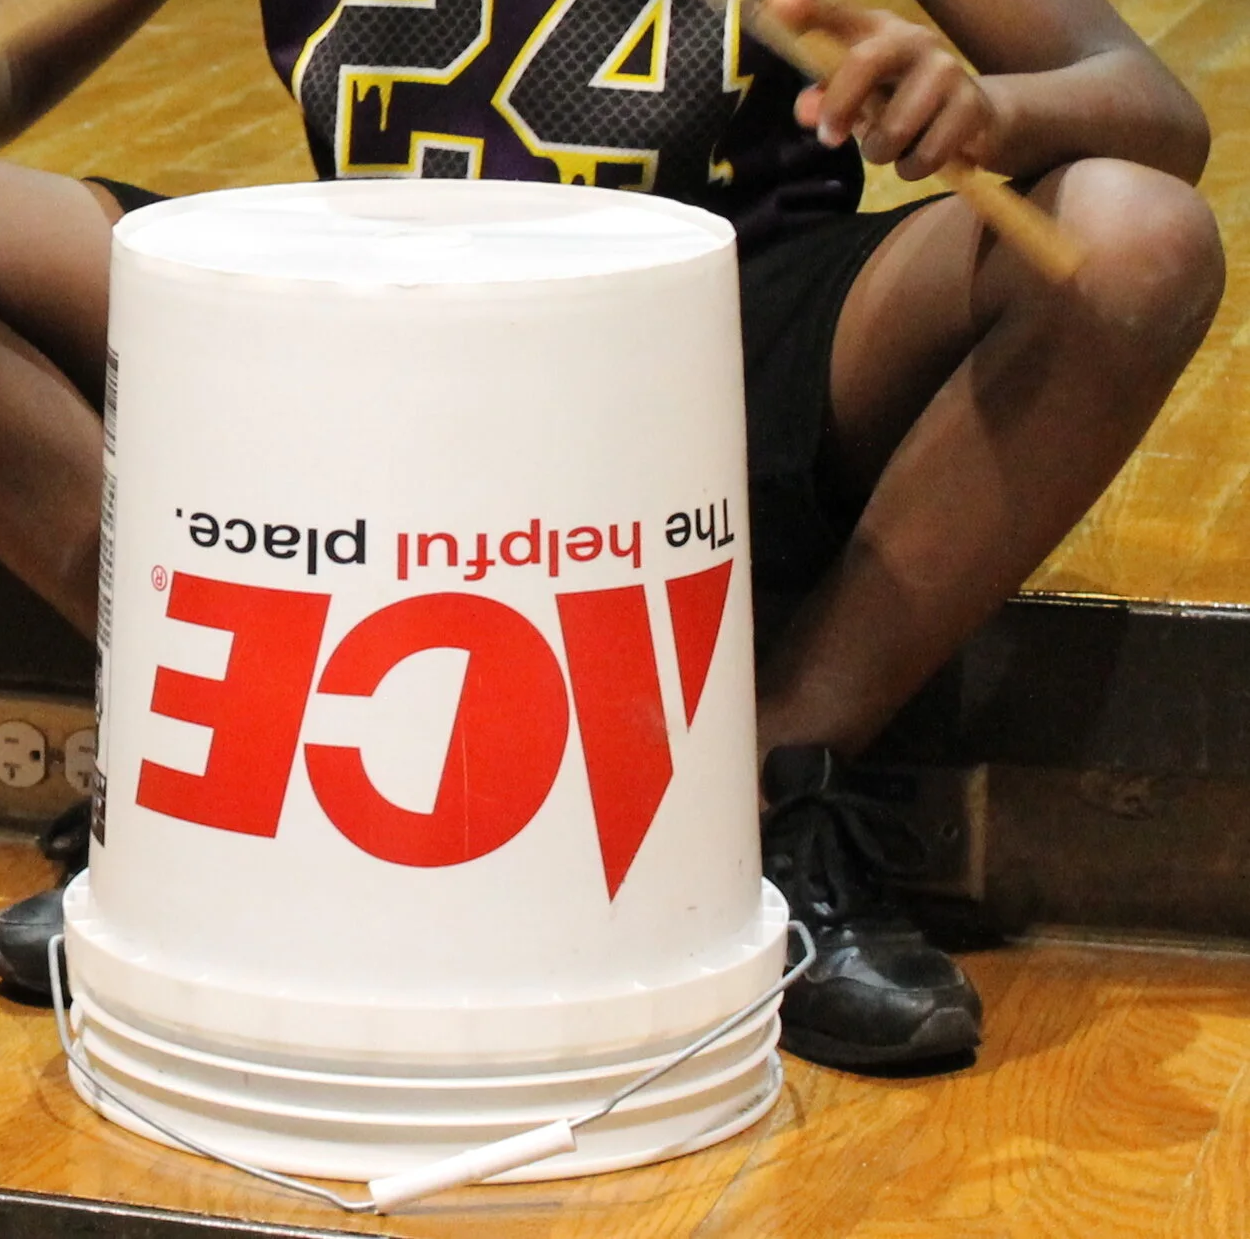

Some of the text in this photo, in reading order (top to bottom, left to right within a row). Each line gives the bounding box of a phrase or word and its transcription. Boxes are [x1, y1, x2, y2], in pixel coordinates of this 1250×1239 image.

[175, 497, 734, 581] The helpful place.
[135, 557, 734, 904] ACE
